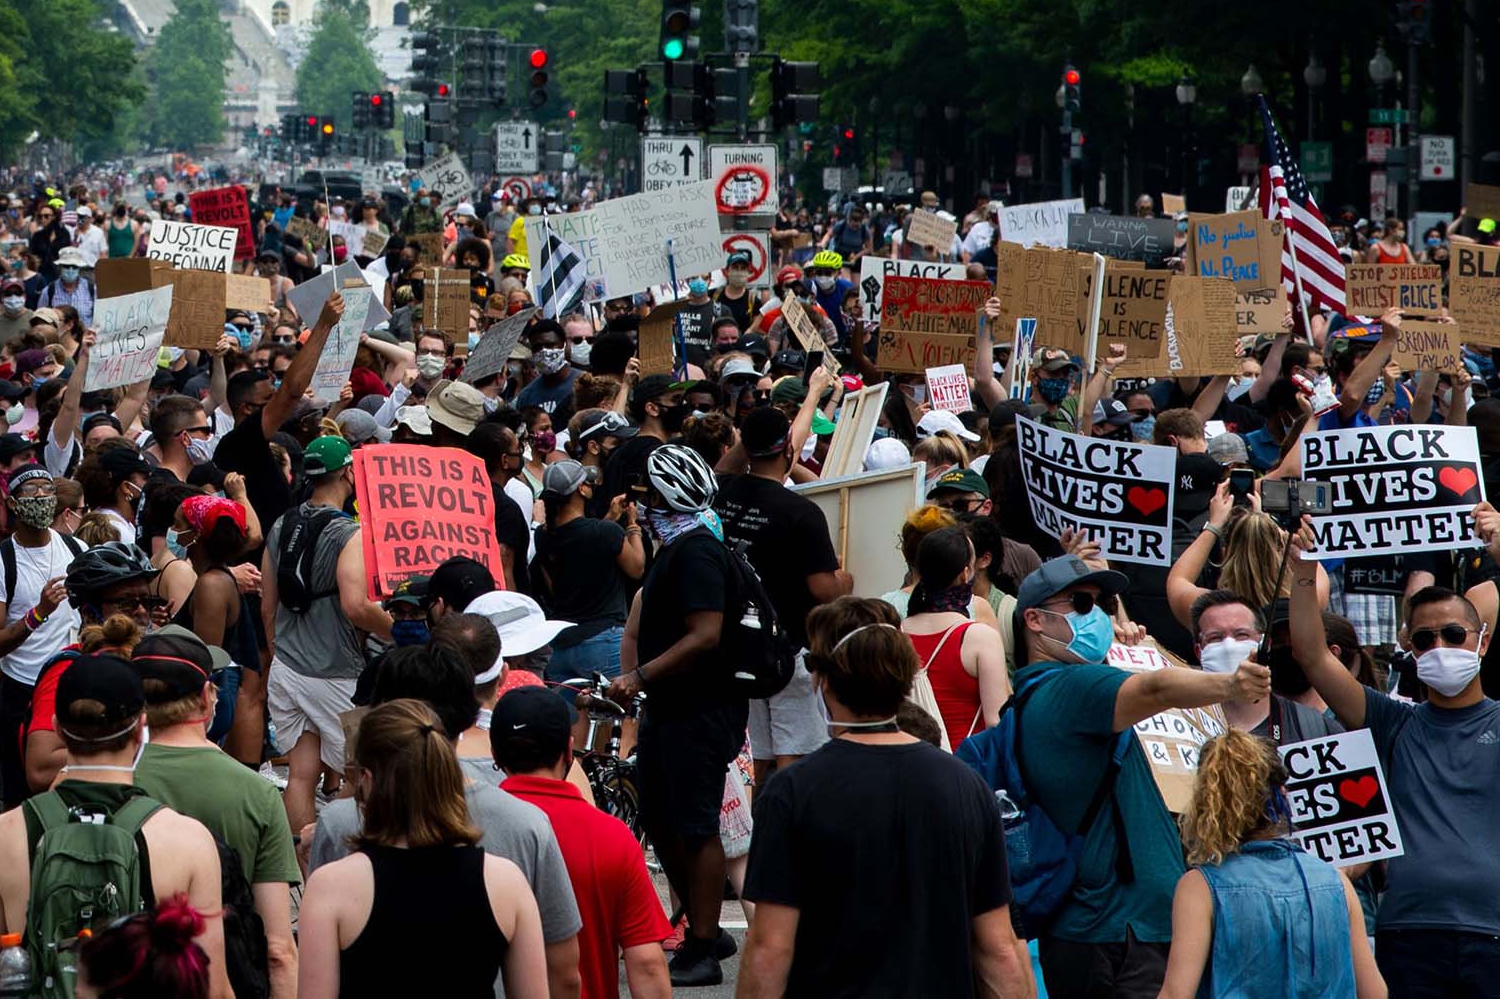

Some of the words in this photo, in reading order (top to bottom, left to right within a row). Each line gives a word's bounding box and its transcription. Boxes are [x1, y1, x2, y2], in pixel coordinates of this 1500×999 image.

[647, 143, 673, 154] THRU
[1429, 140, 1445, 149] NO
[724, 153, 764, 164] TURNING
[621, 202, 651, 215] HAD
[656, 193, 674, 205] TO
[679, 186, 709, 202] ASK
[195, 205, 246, 224] REVOLT
[1008, 209, 1051, 232] BLACK
[1074, 216, 1081, 227] I
[1092, 216, 1149, 231] WANNA
[153, 224, 236, 251] JUSTICE
[624, 232, 650, 246] USE
[654, 229, 663, 241] A
[1198, 224, 1217, 246] No
[1221, 222, 1256, 250] justice
[883, 260, 952, 280] BLACK
[1350, 268, 1384, 281] STOP
[1084, 275, 1167, 301] SLENCE
[1352, 284, 1397, 308] RACIST
[1400, 284, 1438, 310] POLICE
[1115, 302, 1126, 316] IS
[899, 314, 946, 333] WHITE
[1077, 318, 1160, 341] VOLENCE
[99, 325, 149, 359] LIVES
[1396, 330, 1450, 353] BREONNA
[94, 343, 159, 384] MATTER
[1414, 352, 1460, 372] TAYLOR
[930, 375, 948, 388] BLACK
[948, 373, 966, 385] LIVES
[932, 384, 969, 403] MATTER
[1019, 420, 1143, 478] BLACK
[1304, 429, 1449, 469] BLACK
[372, 455, 433, 480] THIS
[440, 460, 463, 482] IS
[471, 465, 486, 488] A
[1024, 458, 1124, 515] LIVES
[1305, 466, 1438, 508] IVES
[378, 483, 489, 517] REVOLT
[383, 520, 492, 550] AGAINST
[1030, 495, 1166, 560] MATTER
[1306, 510, 1477, 553] MATTER
[1273, 724, 1281, 740] EOS
[1152, 743, 1169, 762] &
